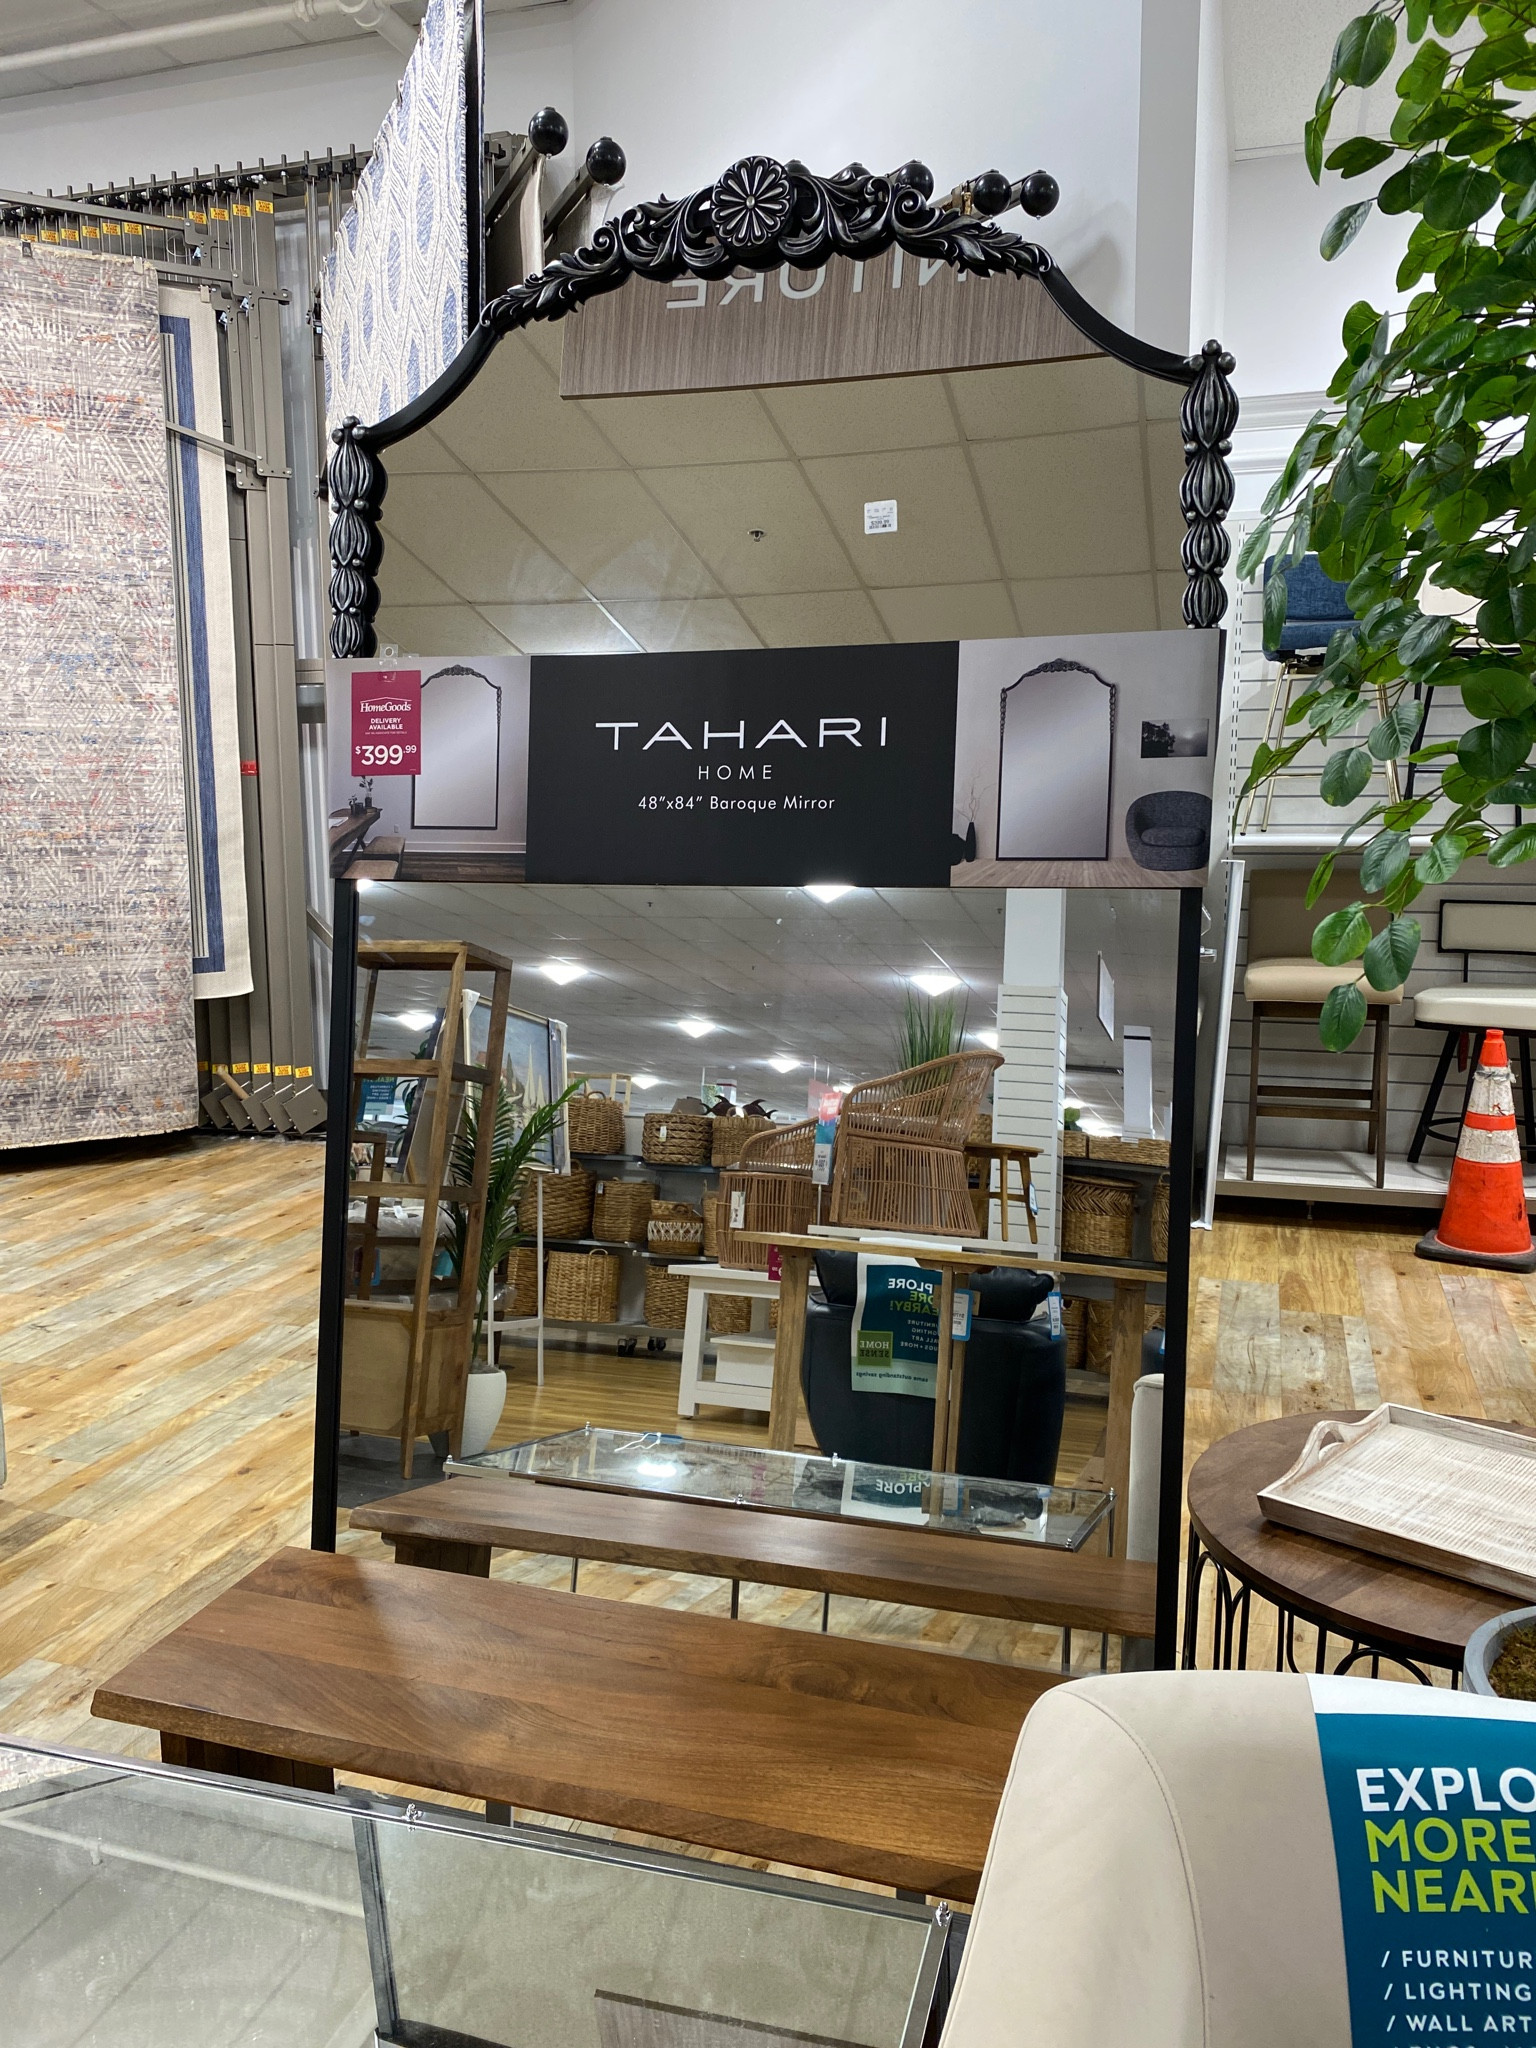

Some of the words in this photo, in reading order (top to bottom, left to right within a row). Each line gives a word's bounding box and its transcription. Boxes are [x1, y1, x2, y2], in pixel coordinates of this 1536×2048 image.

[360, 701, 412, 713] HomeGoods
[595, 716, 888, 751] TAHARI
[355, 744, 417, 766] $399.99
[697, 764, 773, 781] HOME
[709, 795, 777, 814] Baroque
[783, 795, 835, 811] Mirror
[875, 1479, 930, 1494] PLORE
[1364, 1817, 1536, 1863] MORE
[1372, 1869, 1536, 1914] NEAR
[1405, 1982, 1532, 2002] LIGHTING
[1405, 2014, 1474, 2032] WALL
[1483, 2014, 1533, 2033] ART
